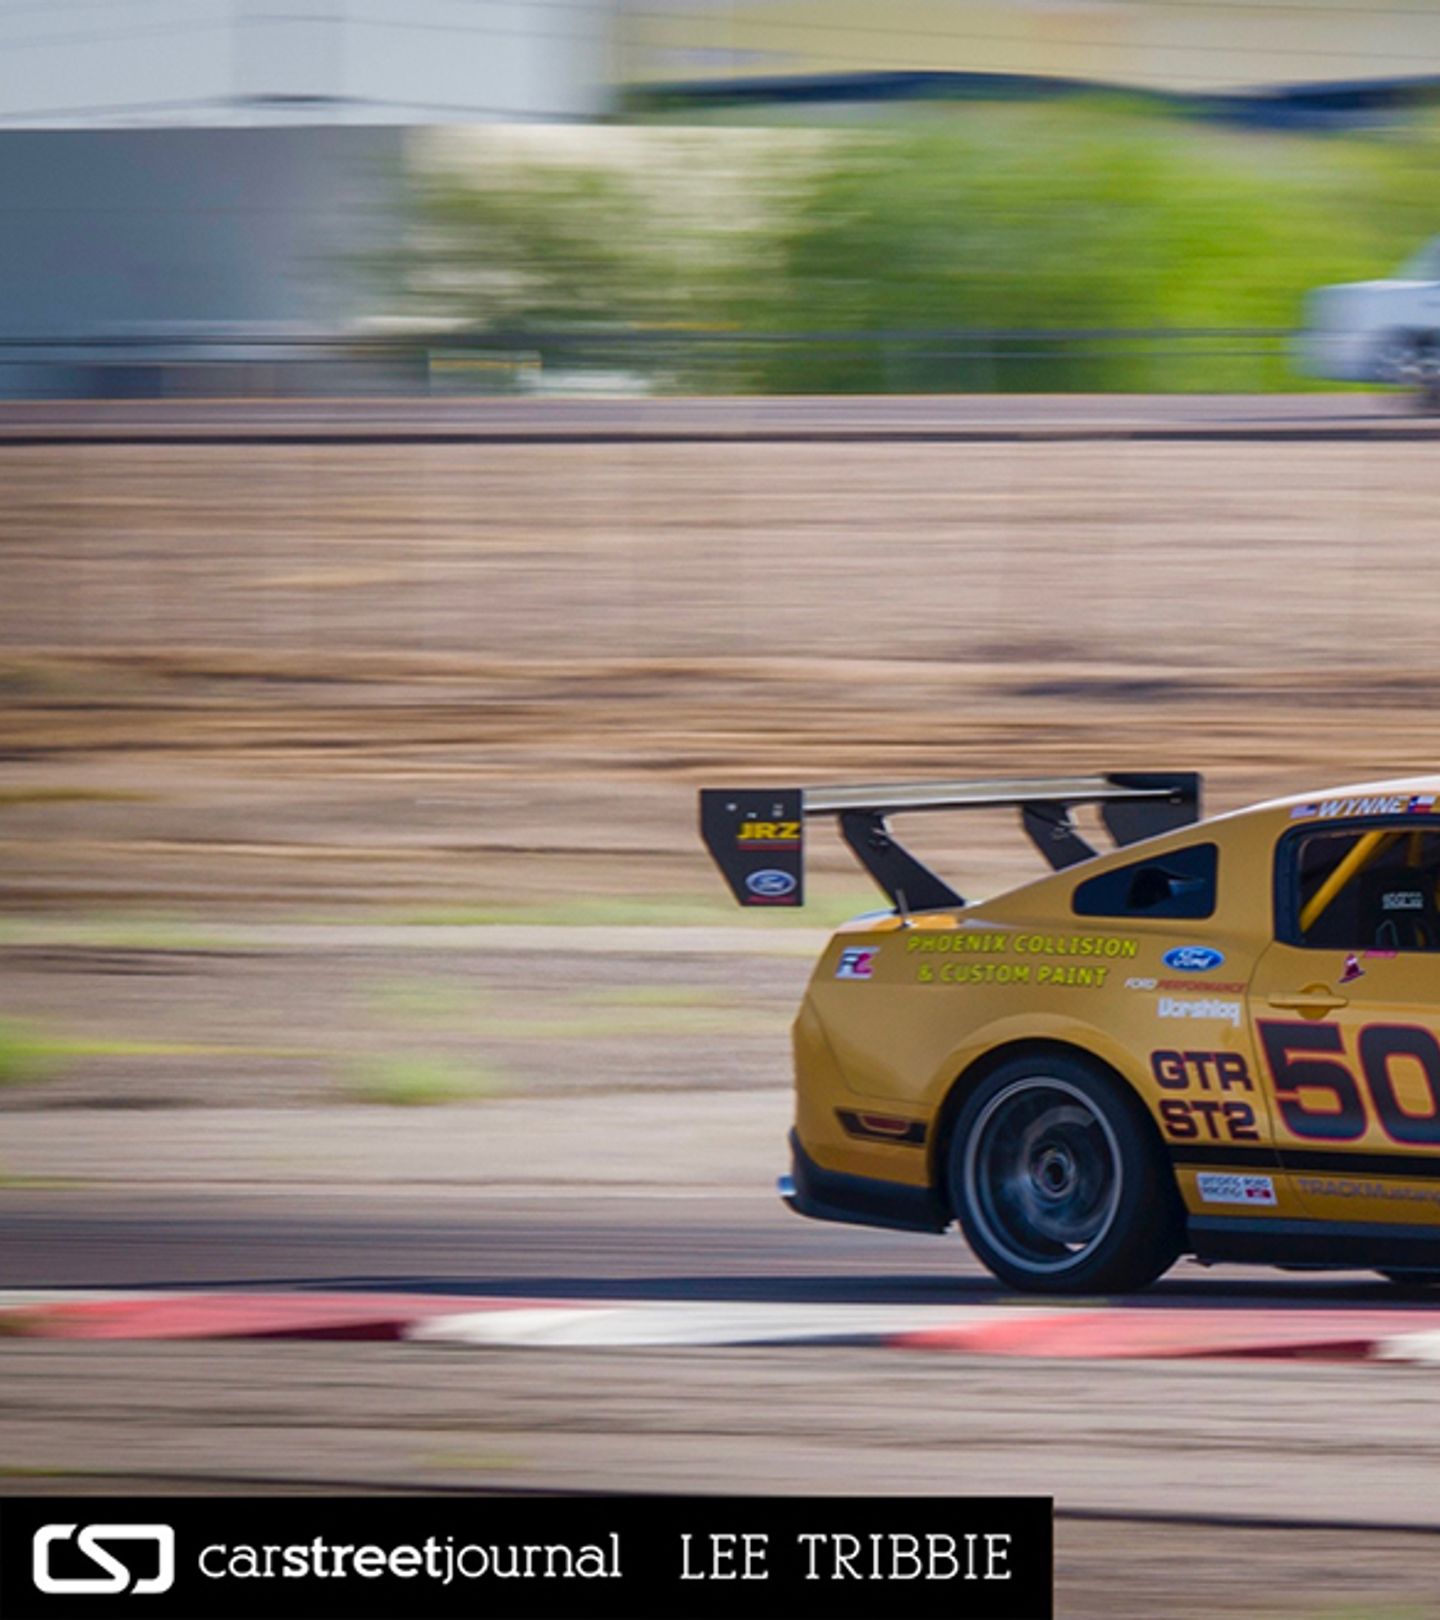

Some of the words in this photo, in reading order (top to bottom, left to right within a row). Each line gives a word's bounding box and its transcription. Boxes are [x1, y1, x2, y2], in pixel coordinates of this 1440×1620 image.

[1318, 797, 1408, 817] WYNNE
[736, 821, 801, 840] JRZ
[907, 935, 1007, 954] PHOENIX
[1013, 935, 1138, 958] COLLISION
[917, 964, 934, 982] &
[940, 964, 1030, 984] CUSTOM
[1037, 965, 1108, 987] PAINT
[1150, 1050, 1254, 1091] GTR
[1159, 1099, 1260, 1141] ST2
